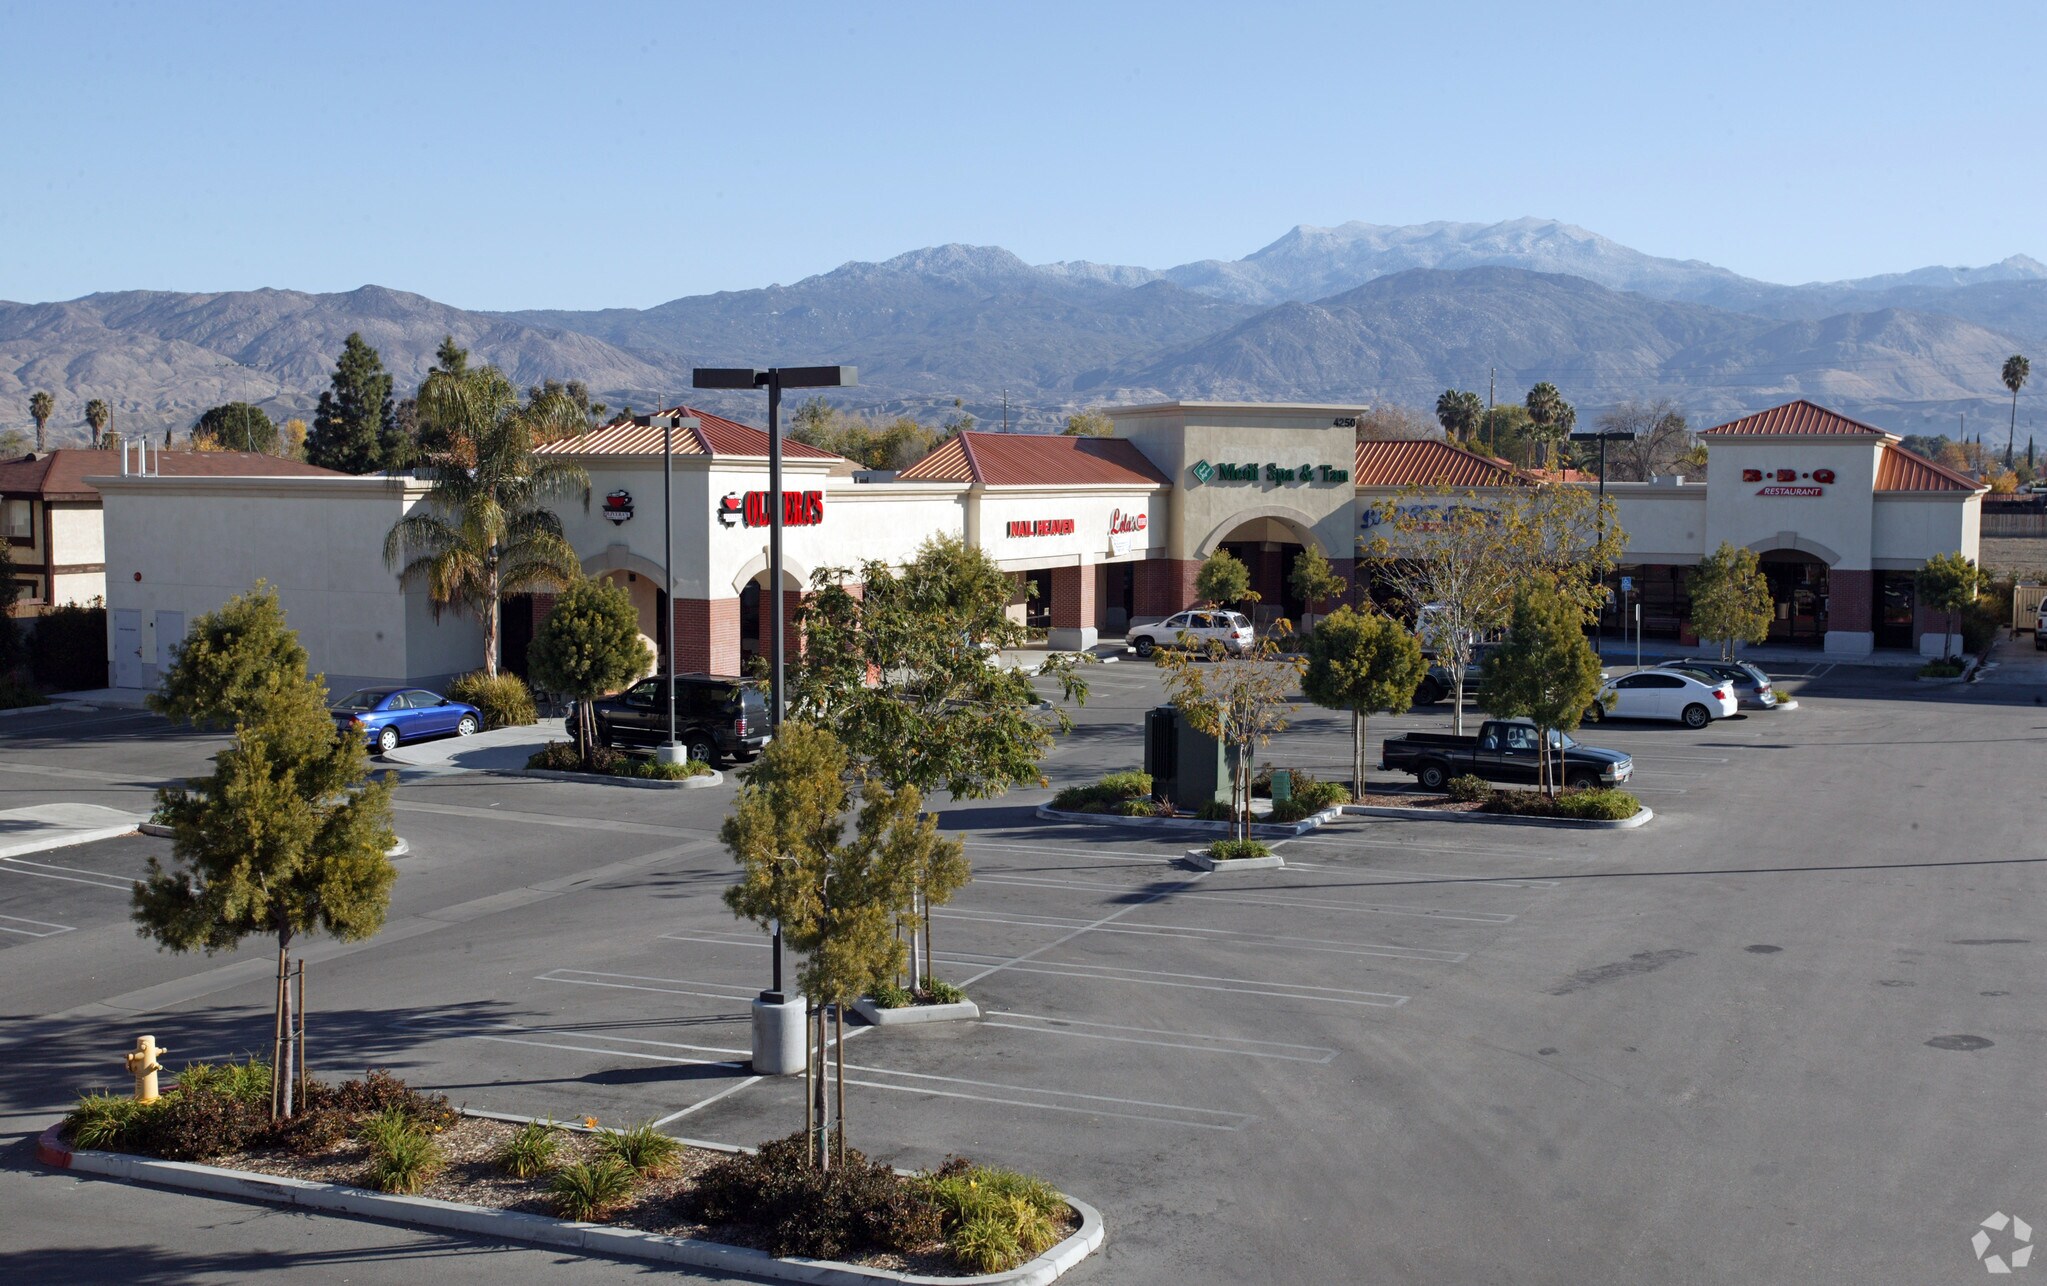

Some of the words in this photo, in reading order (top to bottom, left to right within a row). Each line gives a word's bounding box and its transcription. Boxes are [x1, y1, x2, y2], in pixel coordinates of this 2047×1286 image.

[1333, 418, 1355, 428] 4250
[1218, 463, 1258, 481] Medi
[1266, 463, 1294, 486] Spa
[1299, 464, 1314, 482] &
[1319, 464, 1348, 482] Tan
[1763, 487, 1820, 495] RESTAURANT
[745, 491, 823, 527] OLERA'S
[1010, 520, 1034, 537] NAIL
[1036, 518, 1075, 536] HEAVEN
